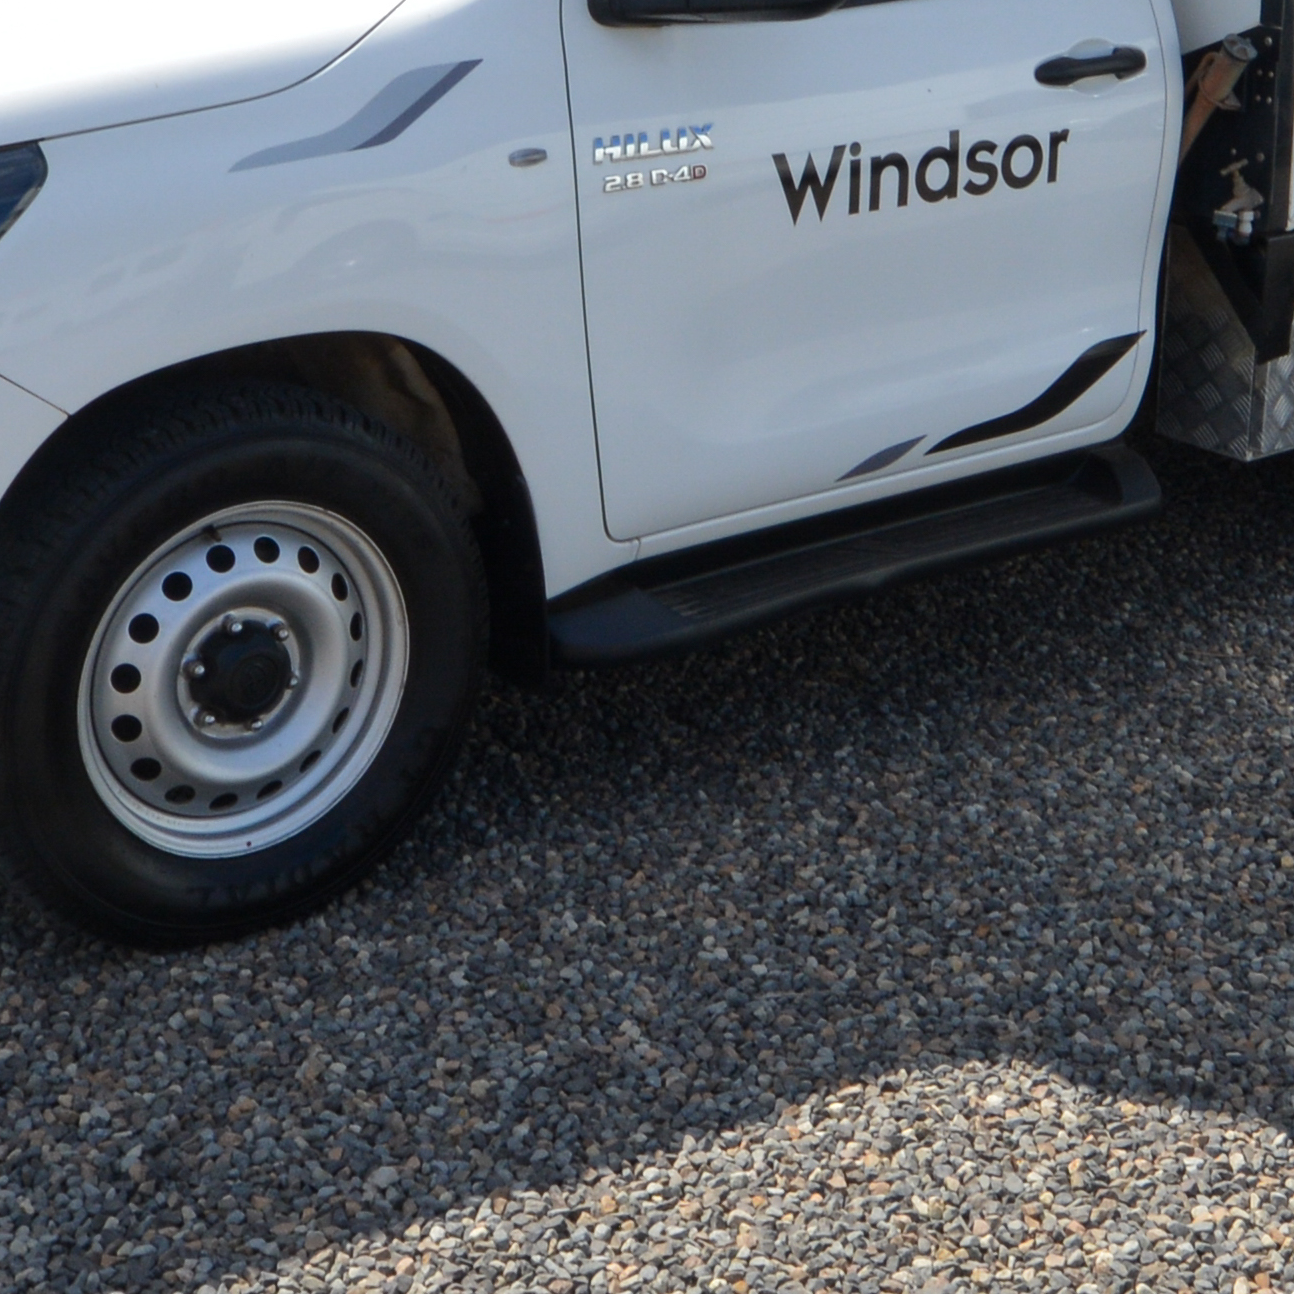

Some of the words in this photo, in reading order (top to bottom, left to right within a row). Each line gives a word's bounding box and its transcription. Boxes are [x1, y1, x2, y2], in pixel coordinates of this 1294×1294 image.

[593, 122, 713, 164] HILUX
[604, 172, 644, 193] 2.8
[772, 129, 1070, 227] Windsor
